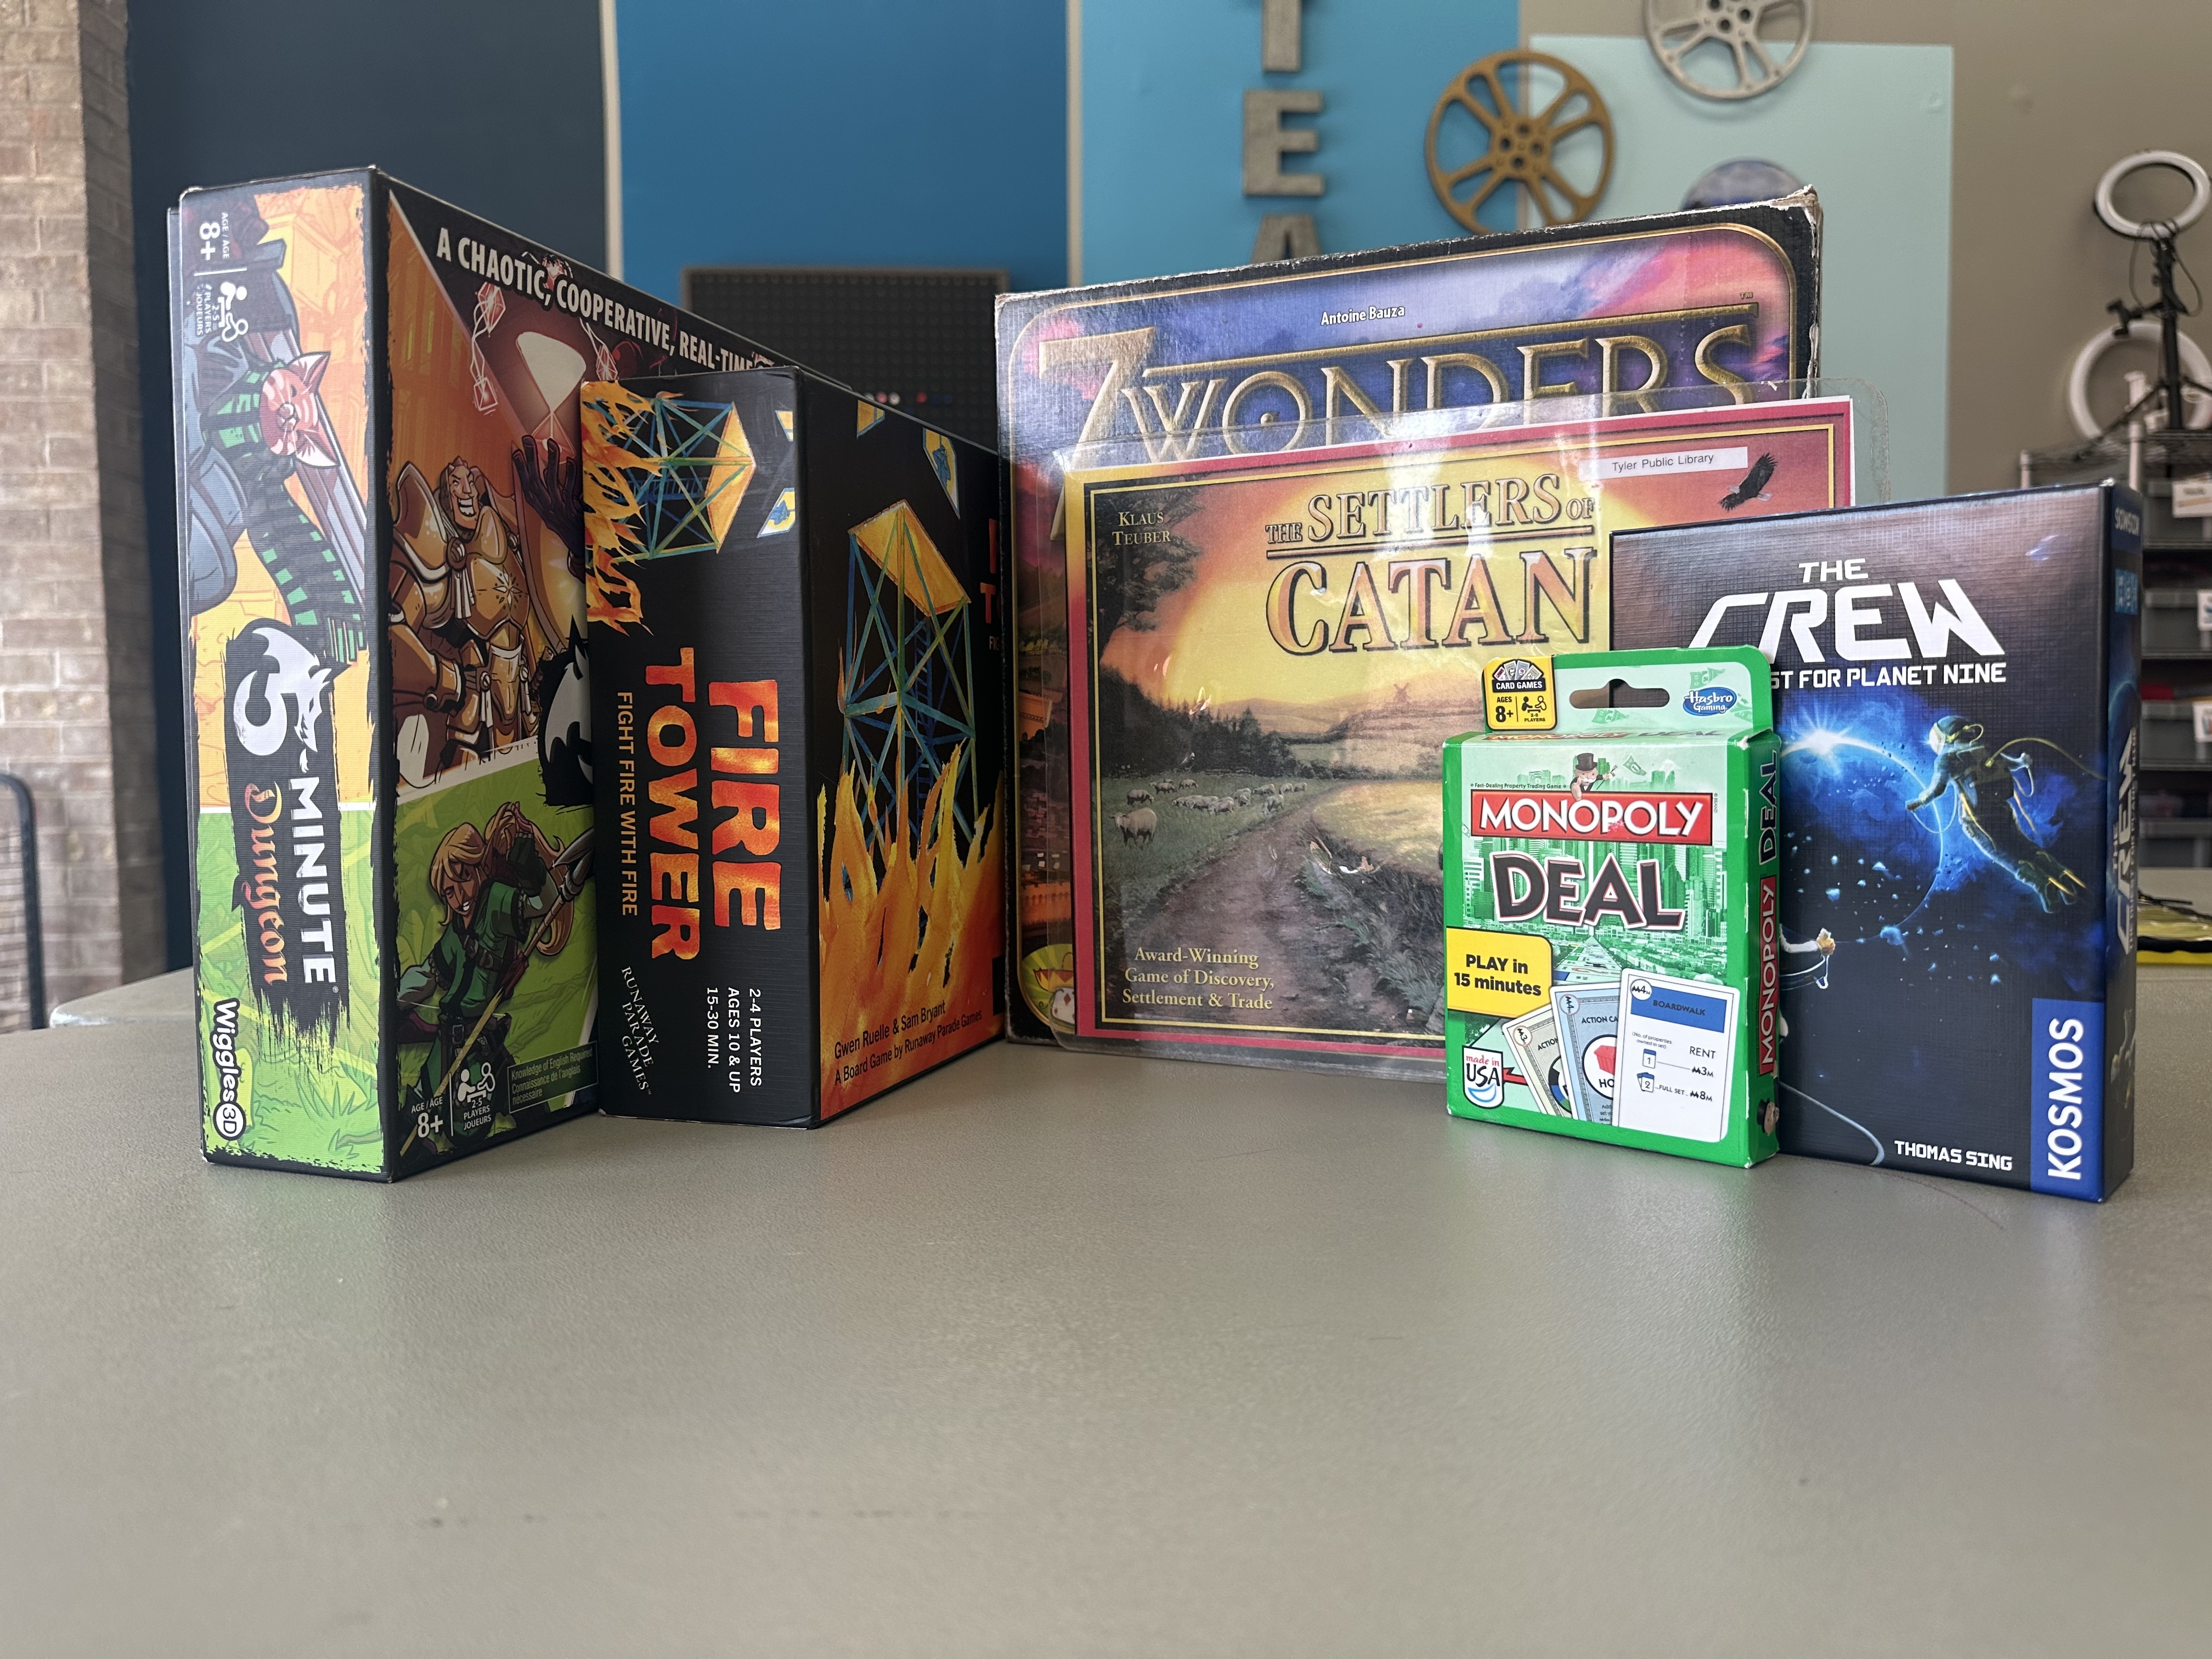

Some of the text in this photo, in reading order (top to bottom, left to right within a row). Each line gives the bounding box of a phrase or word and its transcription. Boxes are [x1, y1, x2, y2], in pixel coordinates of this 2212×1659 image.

[200, 222, 220, 261] 8+
[437, 228, 451, 262] A
[458, 237, 551, 306] CHAOTIC,
[556, 279, 675, 356] COOPERATIVE,
[1321, 304, 1406, 326] Antoine Bauza
[1039, 324, 1751, 541] 7 WONDERS
[1612, 454, 1714, 473] Tyler Public Library
[1118, 511, 1164, 527] KLAUS
[1266, 473, 1595, 544] THE SETTLERS OF
[1112, 531, 1171, 546] TEUBER
[1798, 558, 1869, 583] THE
[1266, 547, 1597, 656] CATAN
[1688, 579, 2006, 664] CREW
[1516, 681, 1542, 689] GAMES
[1799, 668, 1841, 689] FOR
[1847, 665, 1937, 686] PLANET
[1943, 663, 2007, 685] NINE
[1684, 691, 1733, 705] Hasbro
[1694, 702, 1725, 713] Gaming
[1496, 706, 1513, 723] 8+
[617, 691, 637, 916] FIGHT FIRE WITH FIRE
[645, 647, 700, 960] TOWER
[708, 679, 782, 930] FIRE
[1759, 749, 1778, 865] DEAL
[1480, 797, 1704, 837] MONOPOLY
[2117, 728, 2133, 955] CREW
[241, 782, 288, 986] Dungeon
[1490, 851, 1685, 929] DEAL
[1135, 947, 1259, 970] Award-Winning
[1466, 954, 1528, 974] PLAY in
[1125, 967, 1274, 991] Game of Discovery,
[1454, 972, 1541, 996] 15 minutes
[1762, 884, 1776, 1064] MONOPOLY
[621, 966, 659, 1043] RUNAWAY
[1122, 989, 1273, 1009] Settlement & Trade
[1653, 1000, 1706, 1015] BOARDWALK
[707, 987, 719, 1069] 15-30 MIN.
[834, 1000, 946, 1059] Gwen Ruelle & Sam Bryant
[1582, 1016, 1607, 1024] ACTION
[622, 1002, 654, 1067] PARADE
[728, 987, 741, 1093] AGES 10 & UP
[749, 989, 762, 1087] 2-4 PLAYERS
[835, 1010, 982, 1086] A Board Game by Runaway Parade Games
[1466, 1054, 1499, 1066] made in
[1690, 1046, 1716, 1059] RENT
[511, 1046, 593, 1081] Knowledge of English Required
[1466, 1063, 1500, 1087] USA
[512, 1074, 550, 1094] Connaissance
[551, 1071, 558, 1082] de
[1645, 1081, 1651, 1089] 2
[411, 1102, 425, 1113] AGE
[471, 1098, 483, 1109] 2-5
[2047, 1018, 2084, 1180] KOSMOS
[417, 1112, 443, 1138] 8+
[464, 1105, 490, 1120] PLAYERS
[464, 1114, 492, 1130] JOUEURS
[1894, 1140, 2013, 1171] THOMAS SING
